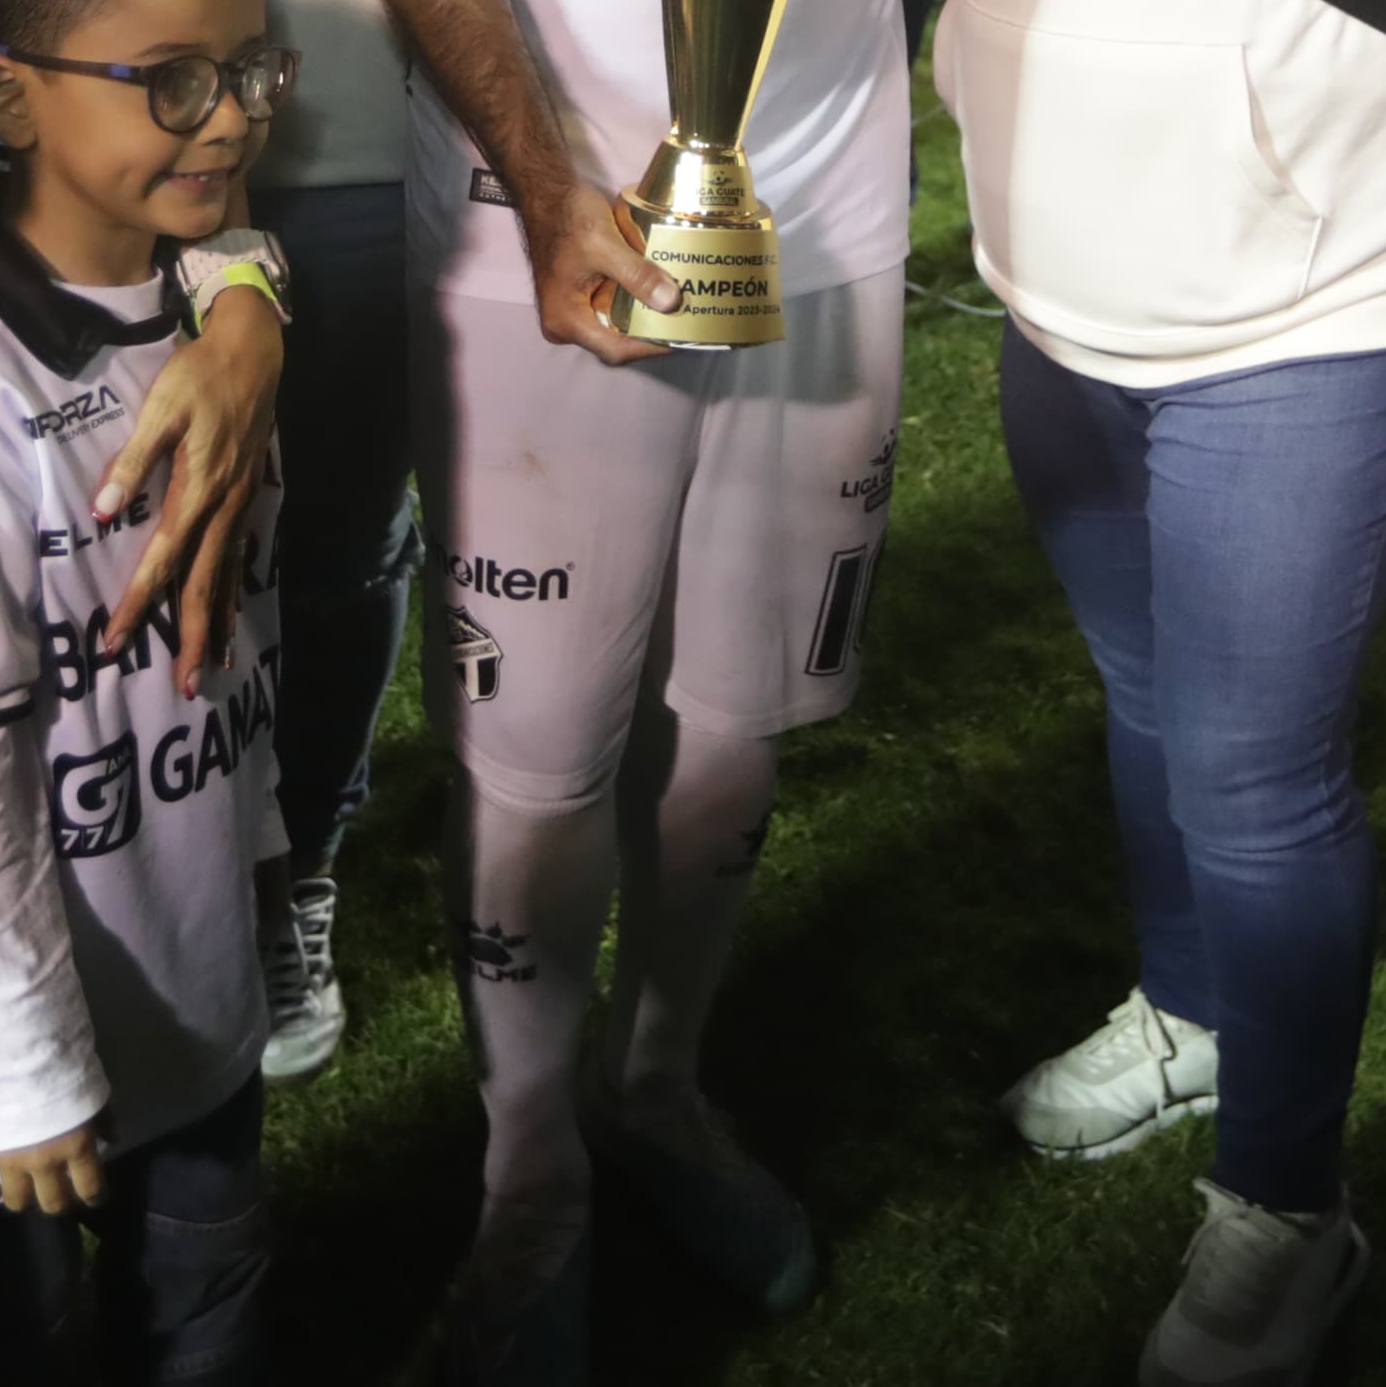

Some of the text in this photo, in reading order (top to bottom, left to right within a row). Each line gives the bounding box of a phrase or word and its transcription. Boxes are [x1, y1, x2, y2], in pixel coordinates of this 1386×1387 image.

[651, 250, 763, 267] COMUNICACIONES
[674, 276, 769, 298] AMPEÓN
[683, 304, 735, 316] Apertura
